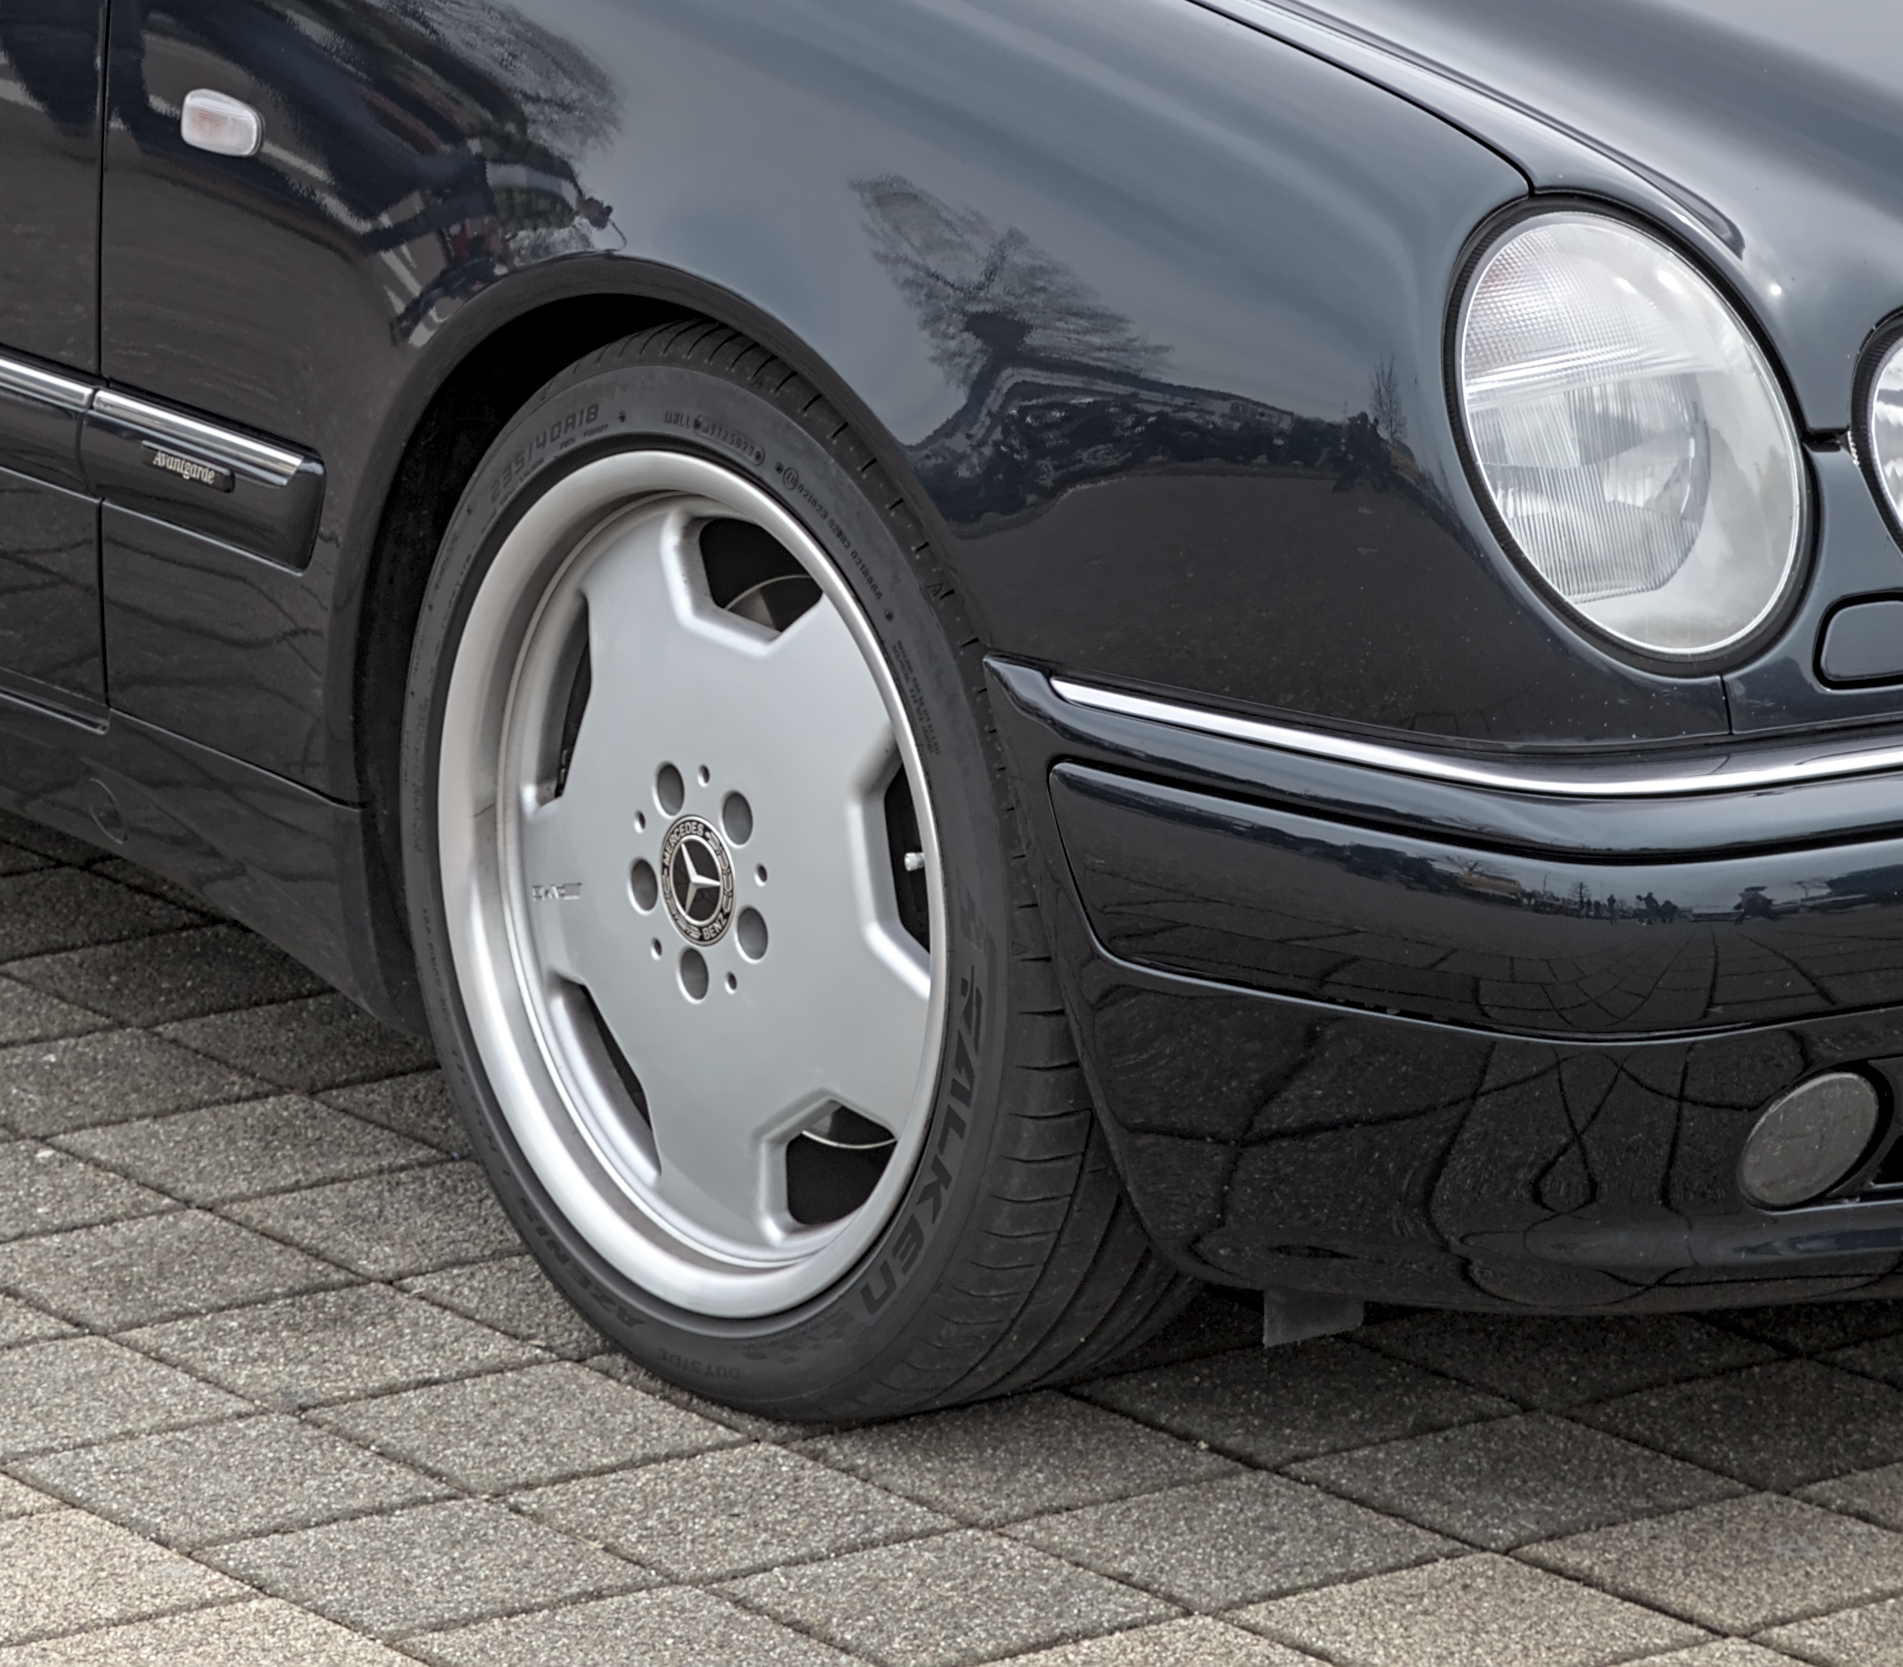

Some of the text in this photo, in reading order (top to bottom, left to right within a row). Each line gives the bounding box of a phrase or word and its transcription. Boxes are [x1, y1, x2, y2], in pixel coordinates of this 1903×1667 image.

[152, 450, 216, 485] Avantgarde
[662, 821, 704, 867] MERCEDES
[702, 912, 728, 941] BENZ
[860, 964, 983, 1315] FALKEN
[656, 1345, 742, 1381] OUTSIDE
